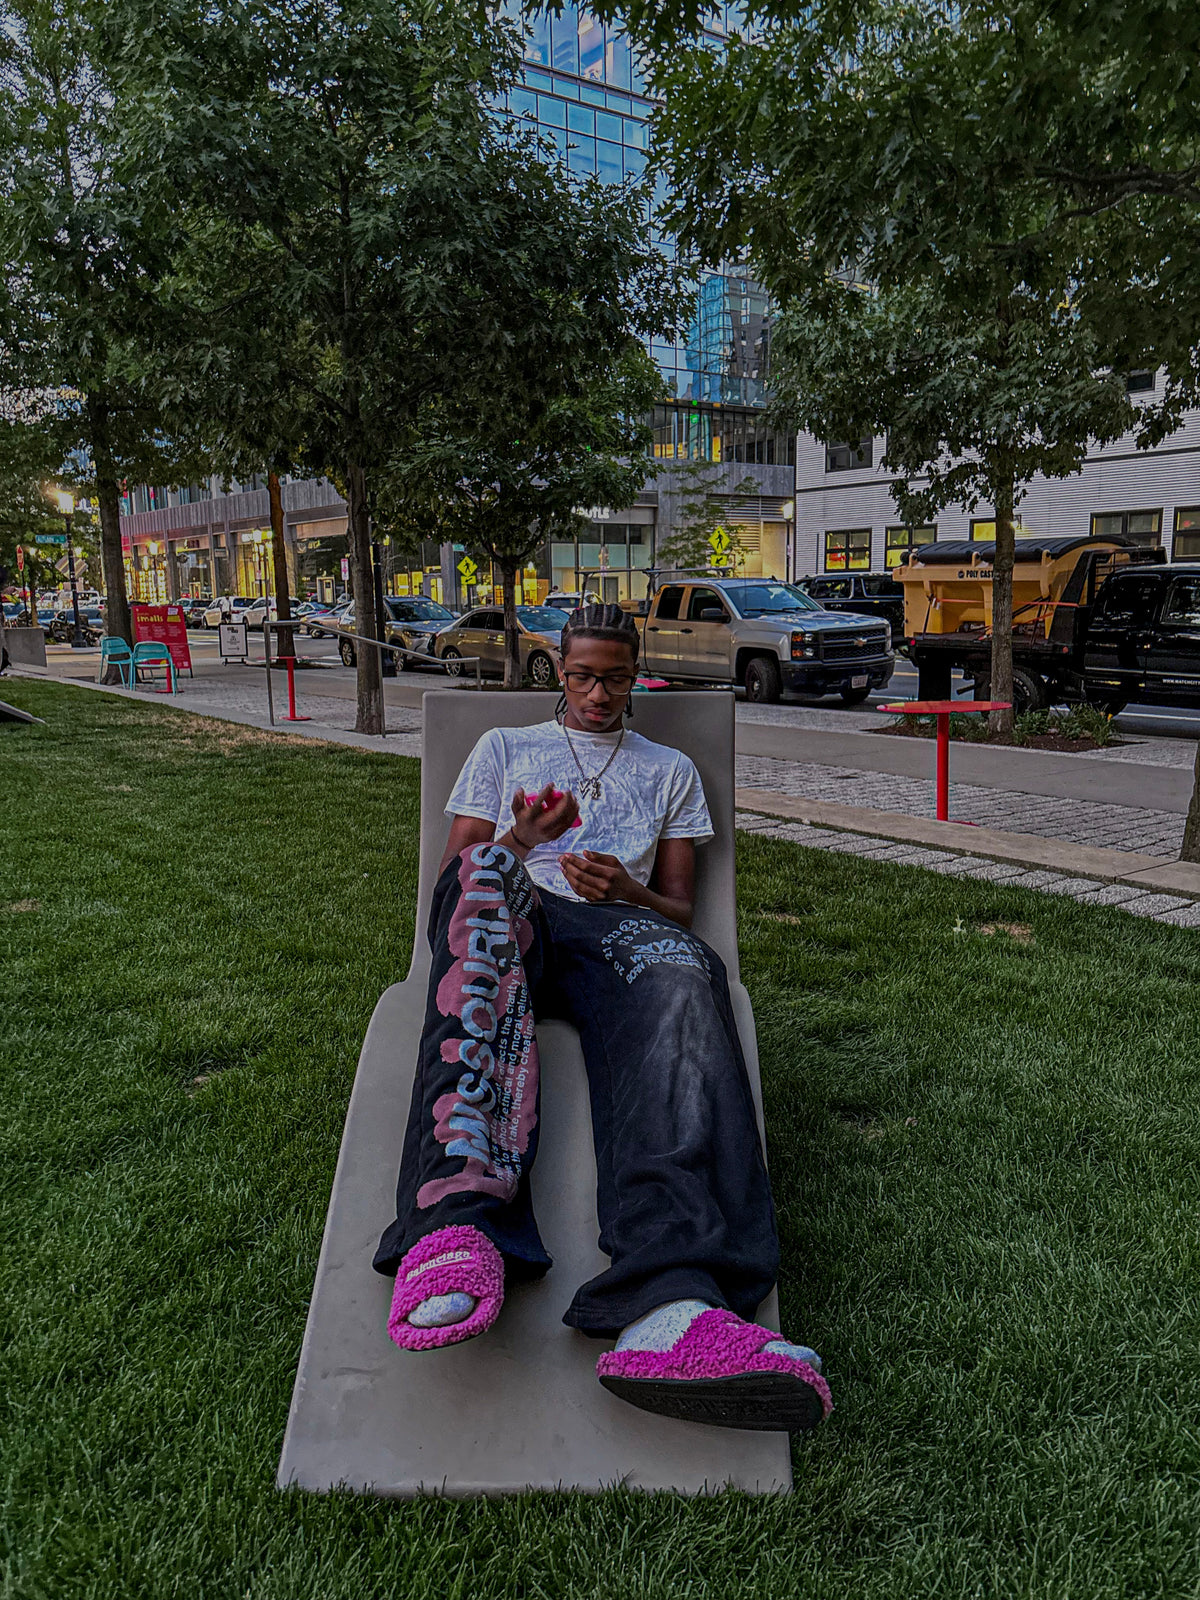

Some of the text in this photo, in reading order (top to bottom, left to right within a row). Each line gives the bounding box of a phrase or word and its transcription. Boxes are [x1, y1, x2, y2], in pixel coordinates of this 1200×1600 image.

[966, 570, 978, 578] POLY
[631, 938, 691, 954] 2024
[508, 964, 521, 976] of
[625, 962, 646, 985] BORN
[504, 978, 521, 1014] clarity
[500, 1016, 513, 1036] the
[511, 1019, 523, 1051] moral
[520, 1018, 534, 1065] creating
[507, 1052, 517, 1075] and
[501, 1077, 513, 1115] ethical
[510, 1067, 529, 1110] thereby
[498, 1115, 509, 1152] uphold
[508, 1114, 521, 1142] take,
[490, 1144, 500, 1155] is
[501, 1152, 510, 1163] to
[510, 1144, 521, 1163] they
